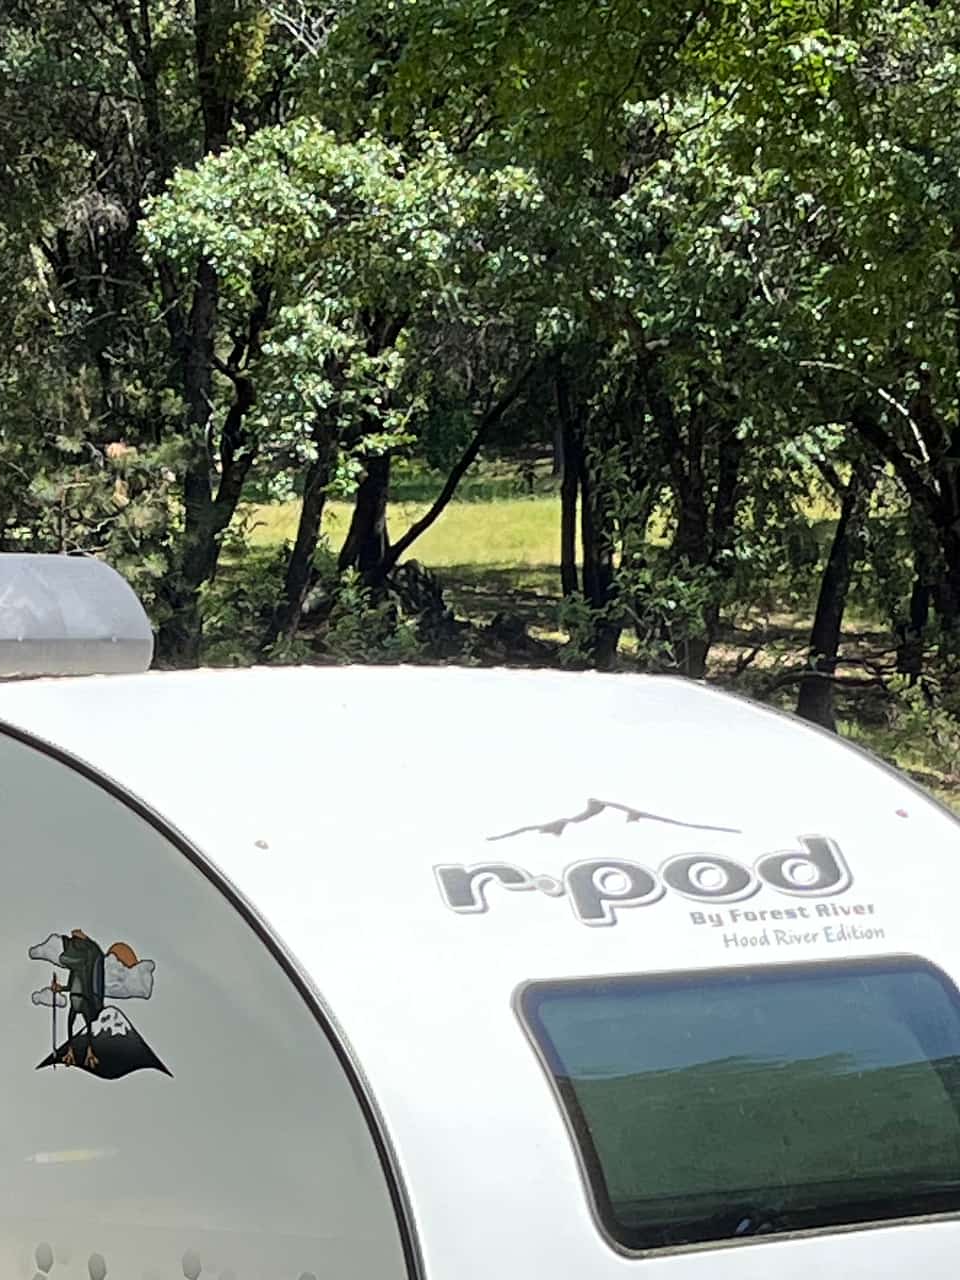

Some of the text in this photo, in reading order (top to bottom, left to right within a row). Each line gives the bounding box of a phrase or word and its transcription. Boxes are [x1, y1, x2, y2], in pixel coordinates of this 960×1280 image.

[689, 903, 875, 928] By Forest River
[722, 923, 886, 949] Hood River Edition
